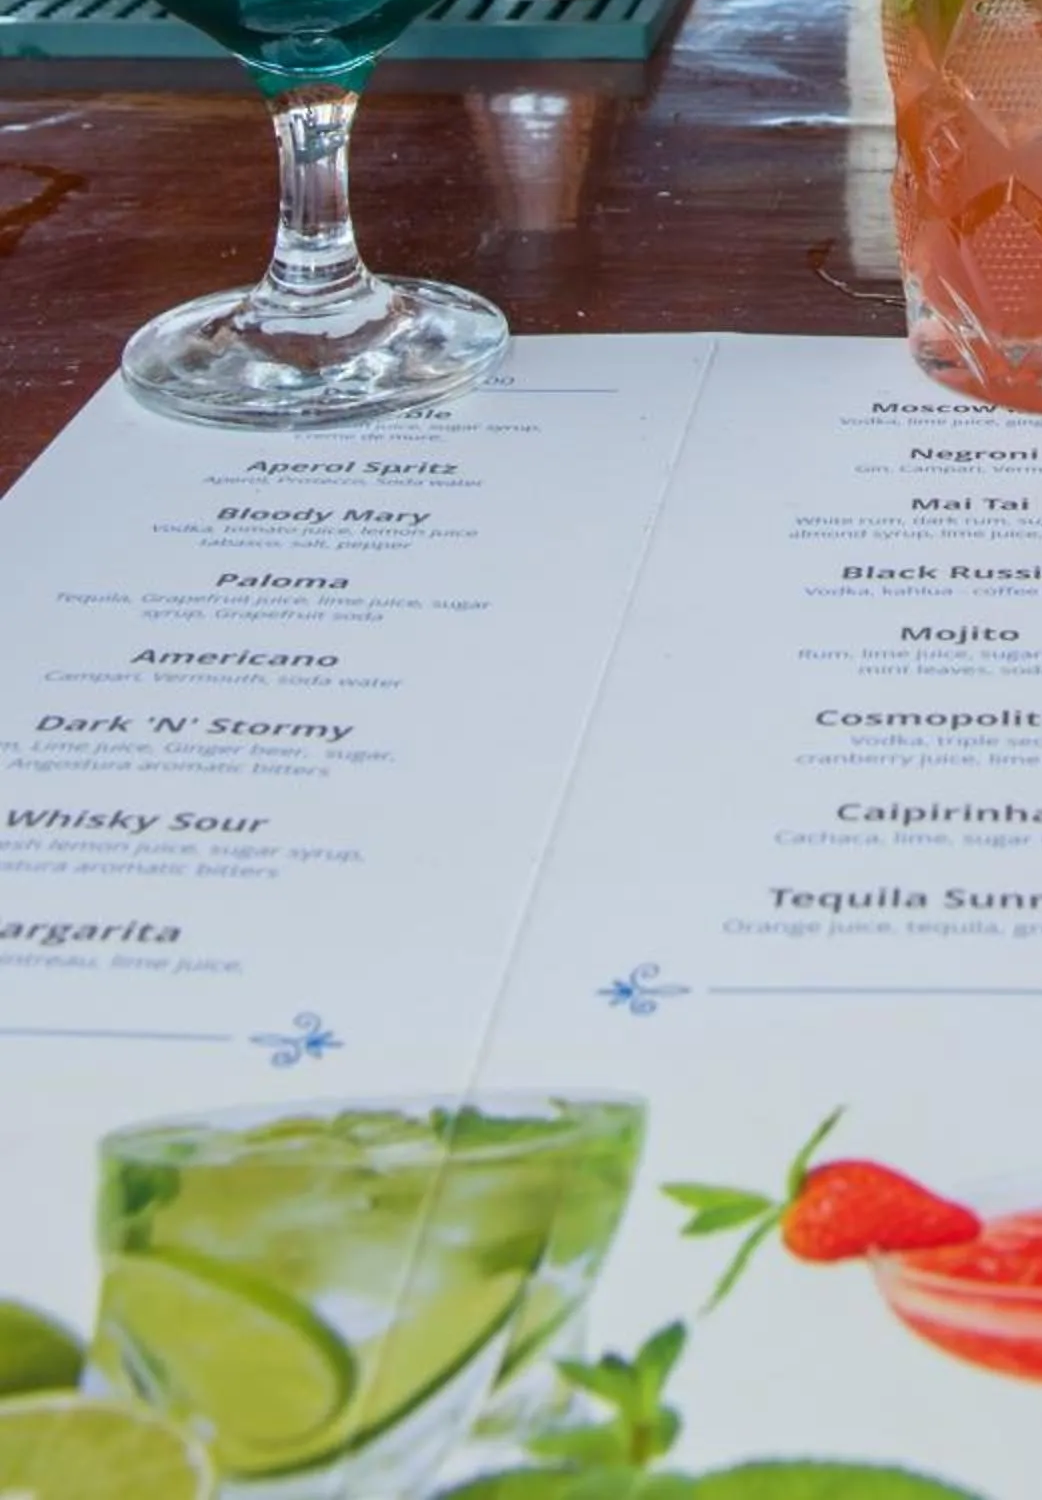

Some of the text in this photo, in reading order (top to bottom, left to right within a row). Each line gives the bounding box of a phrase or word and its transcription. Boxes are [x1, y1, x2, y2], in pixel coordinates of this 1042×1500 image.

[872, 403, 998, 413] Moscow
[907, 417, 947, 426] lime
[910, 448, 1038, 462] Negroni
[247, 461, 458, 476] Aperol Spritz
[912, 498, 1029, 510] Mai Tai
[217, 508, 431, 528] Bloody Mary
[796, 516, 853, 527] White
[913, 515, 957, 526] dark
[789, 529, 867, 540] almond
[941, 528, 985, 539] lime
[842, 566, 937, 579] Black
[216, 574, 349, 589] Paloma
[882, 585, 953, 597] kahlua
[972, 585, 1038, 597] coffee
[901, 626, 1019, 645] Mojito
[130, 649, 339, 667] Americano
[862, 648, 910, 660] lime
[981, 649, 1041, 663] sugar
[858, 665, 909, 676] mint
[36, 715, 354, 743] Dark 'N' Stormy
[937, 734, 999, 750] triple
[794, 752, 913, 768] cranberry
[989, 752, 1040, 767] lime
[6, 810, 269, 834] Whisky Sour
[963, 833, 1031, 849] sugar
[770, 888, 927, 914] Tequila
[722, 917, 821, 939] Orange
